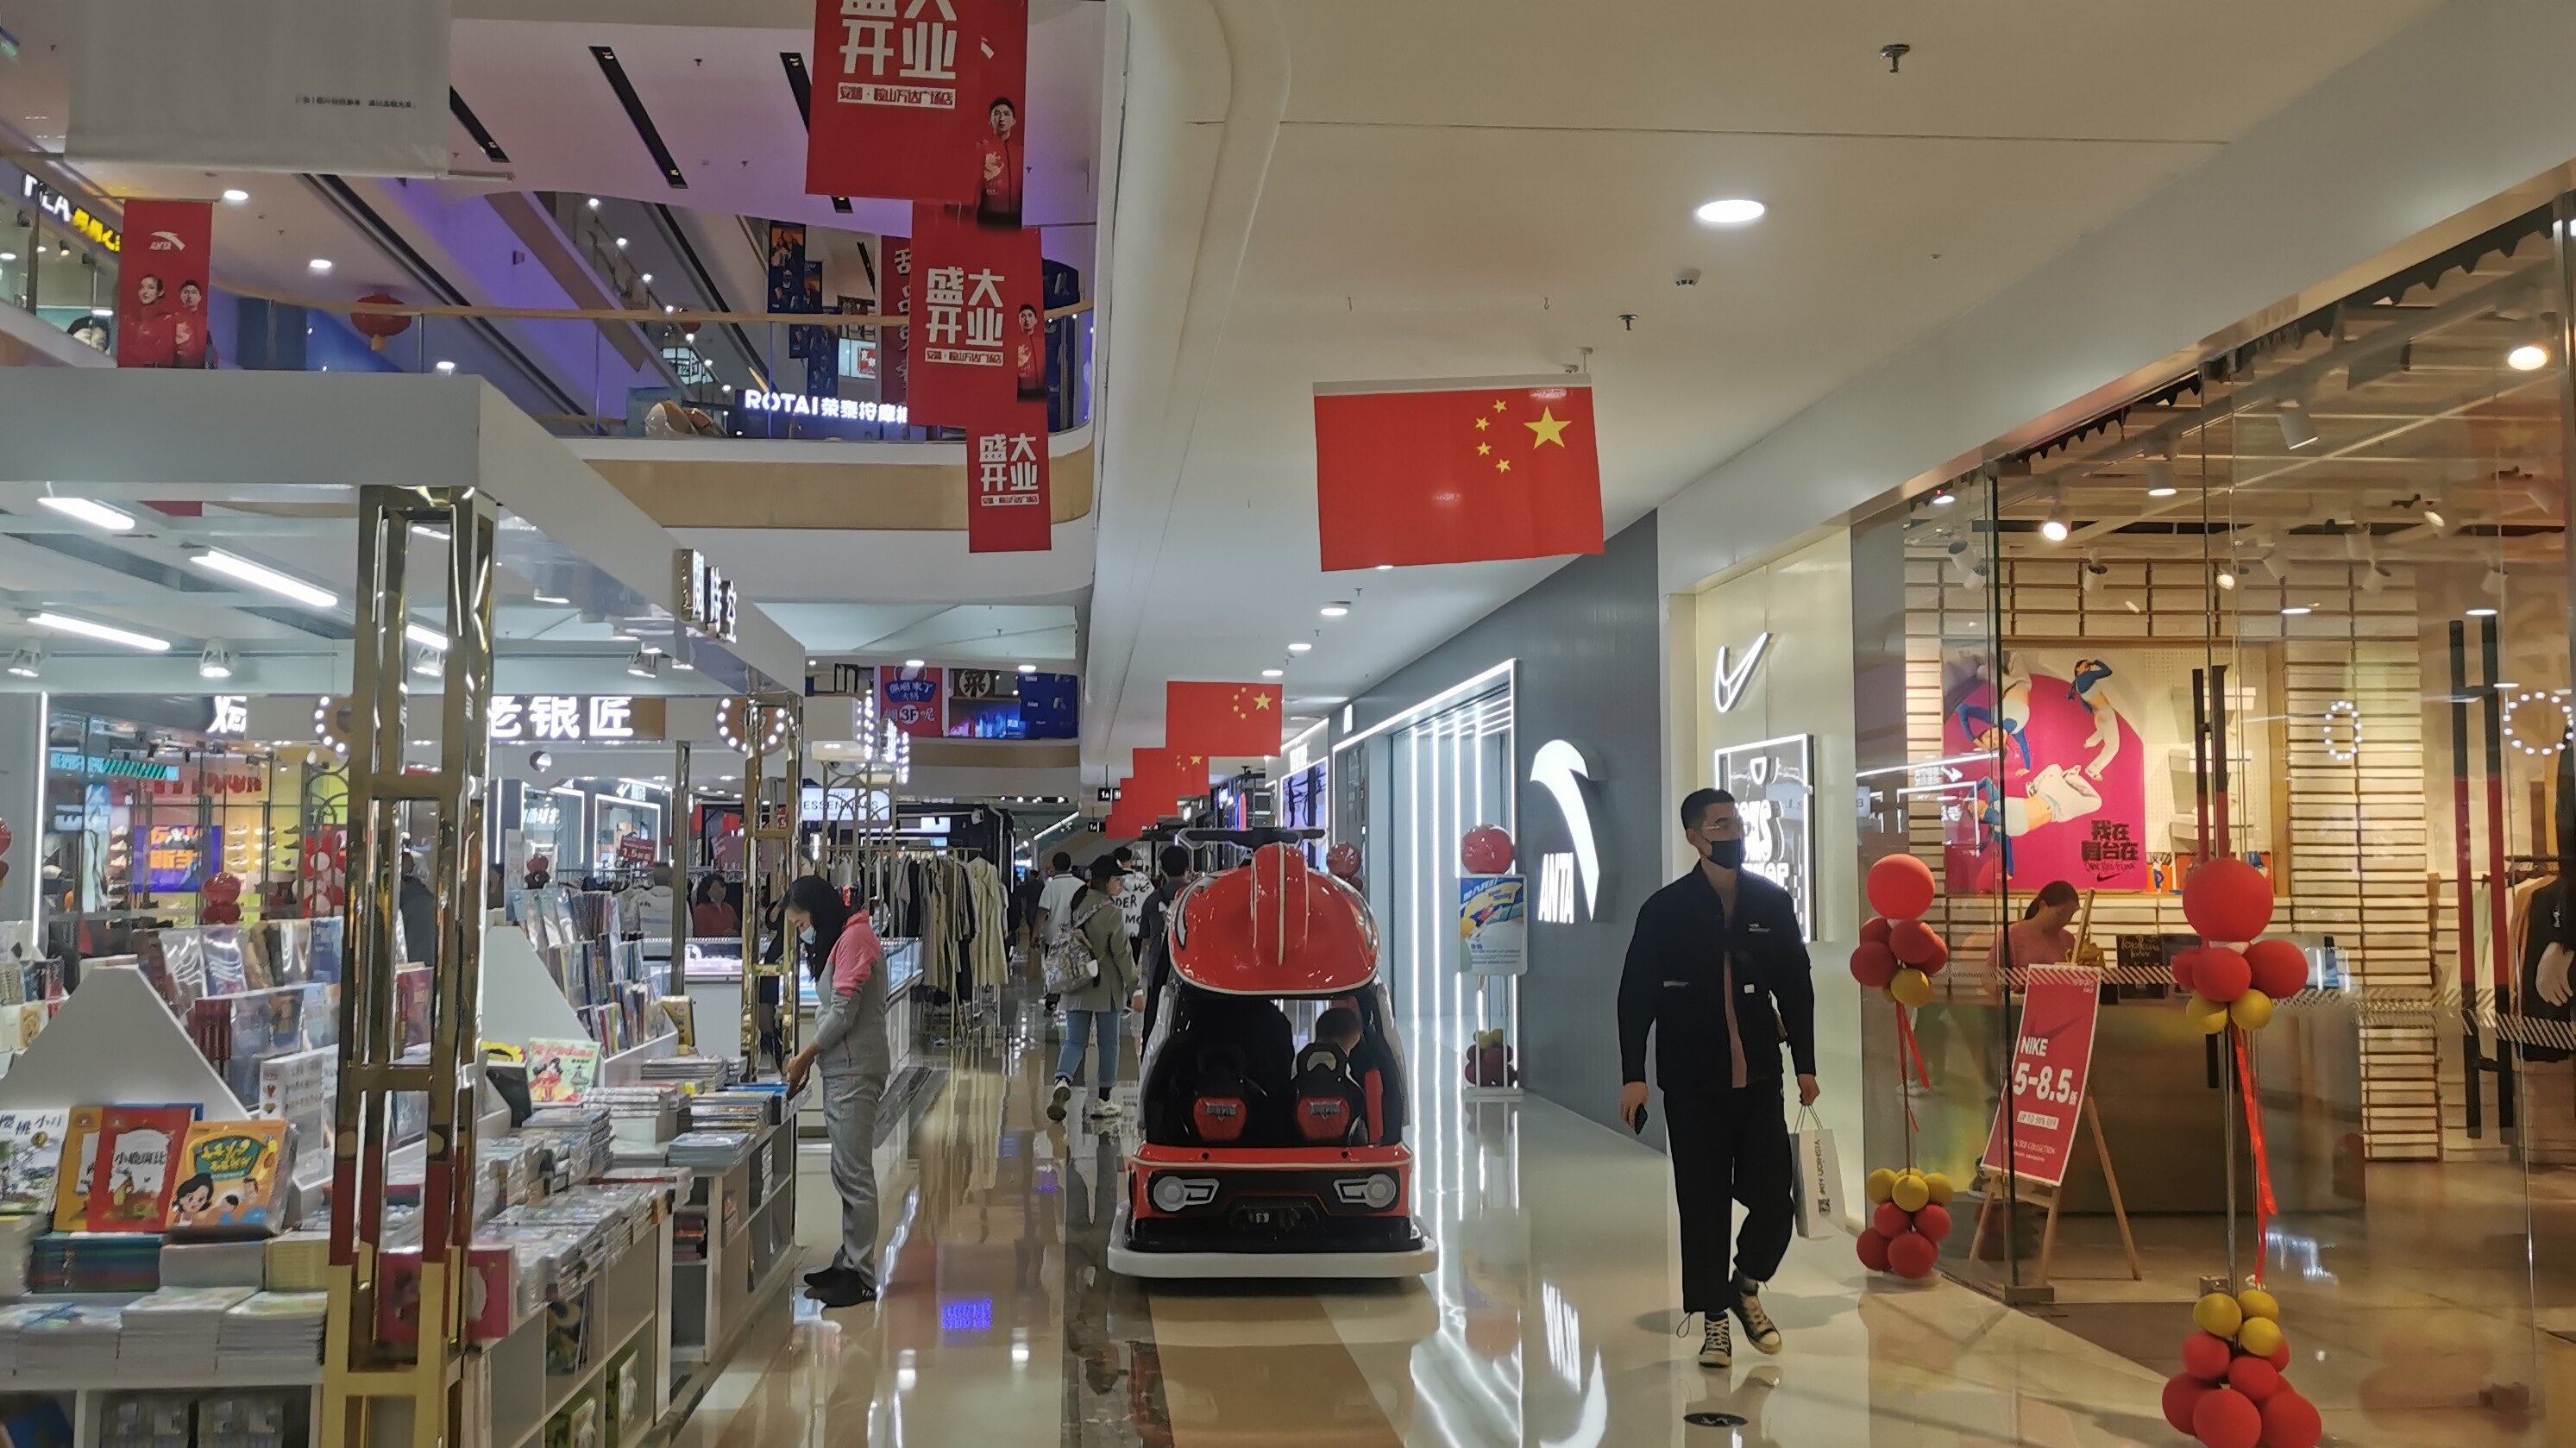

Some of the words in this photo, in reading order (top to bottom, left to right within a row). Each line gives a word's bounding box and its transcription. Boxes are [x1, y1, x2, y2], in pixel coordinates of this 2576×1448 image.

[839, 18, 957, 79] 开业
[926, 266, 1005, 308] 盛大
[926, 305, 1003, 347] 开业
[745, 389, 818, 416] ROTAI
[979, 433, 1037, 462] 盛大
[980, 461, 1038, 492] 开业
[1112, 894, 1137, 909] DER
[1538, 851, 1574, 925] ANTA
[2020, 1035, 2049, 1057] NIKE
